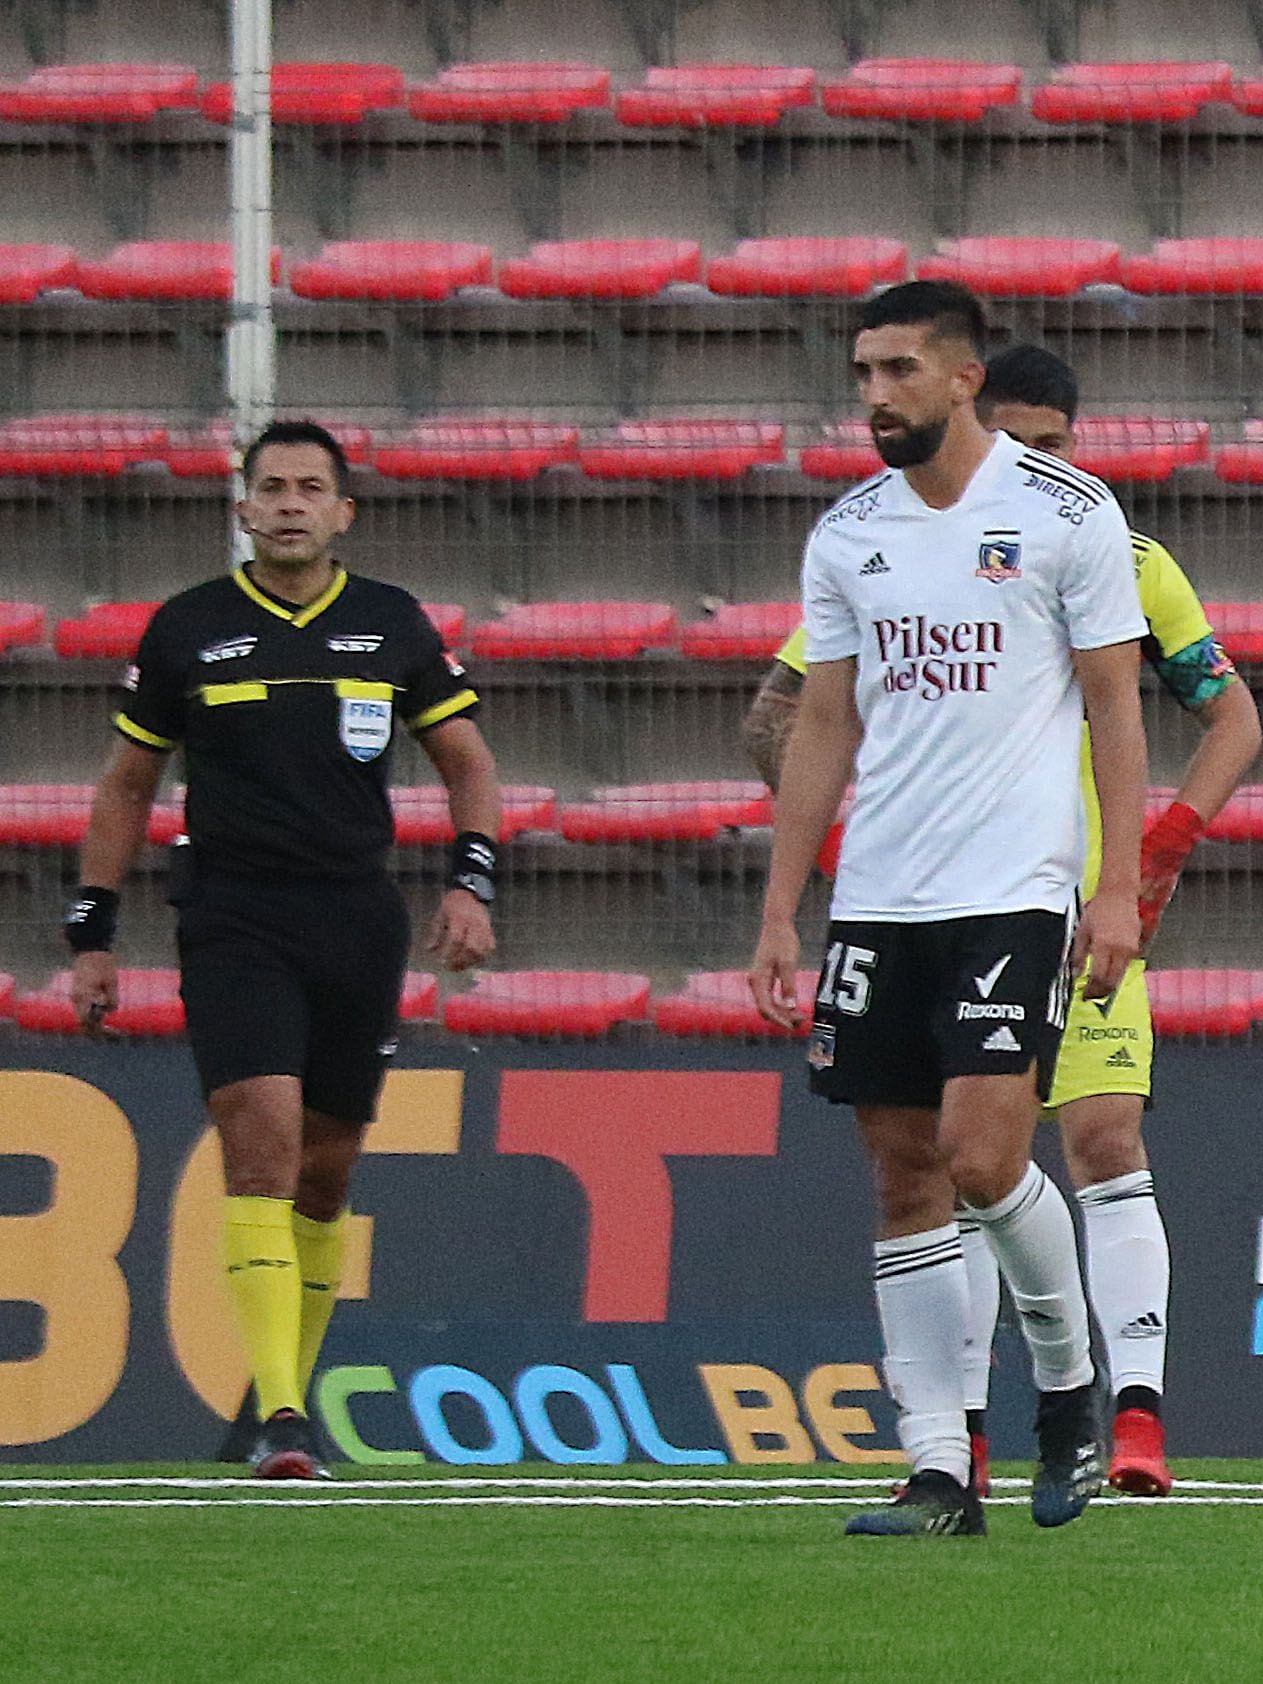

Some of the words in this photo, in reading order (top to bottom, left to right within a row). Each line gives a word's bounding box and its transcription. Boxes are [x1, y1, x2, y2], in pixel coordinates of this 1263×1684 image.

[1023, 473, 1096, 514] DIRECTV
[1056, 505, 1084, 526] GO
[873, 615, 1005, 664] Pilsen
[883, 661, 919, 693] del
[922, 657, 998, 702] Sur
[816, 941, 879, 1018] 15
[956, 1000, 1026, 1021] Rexona
[316, 1363, 908, 1466] COOLBE
